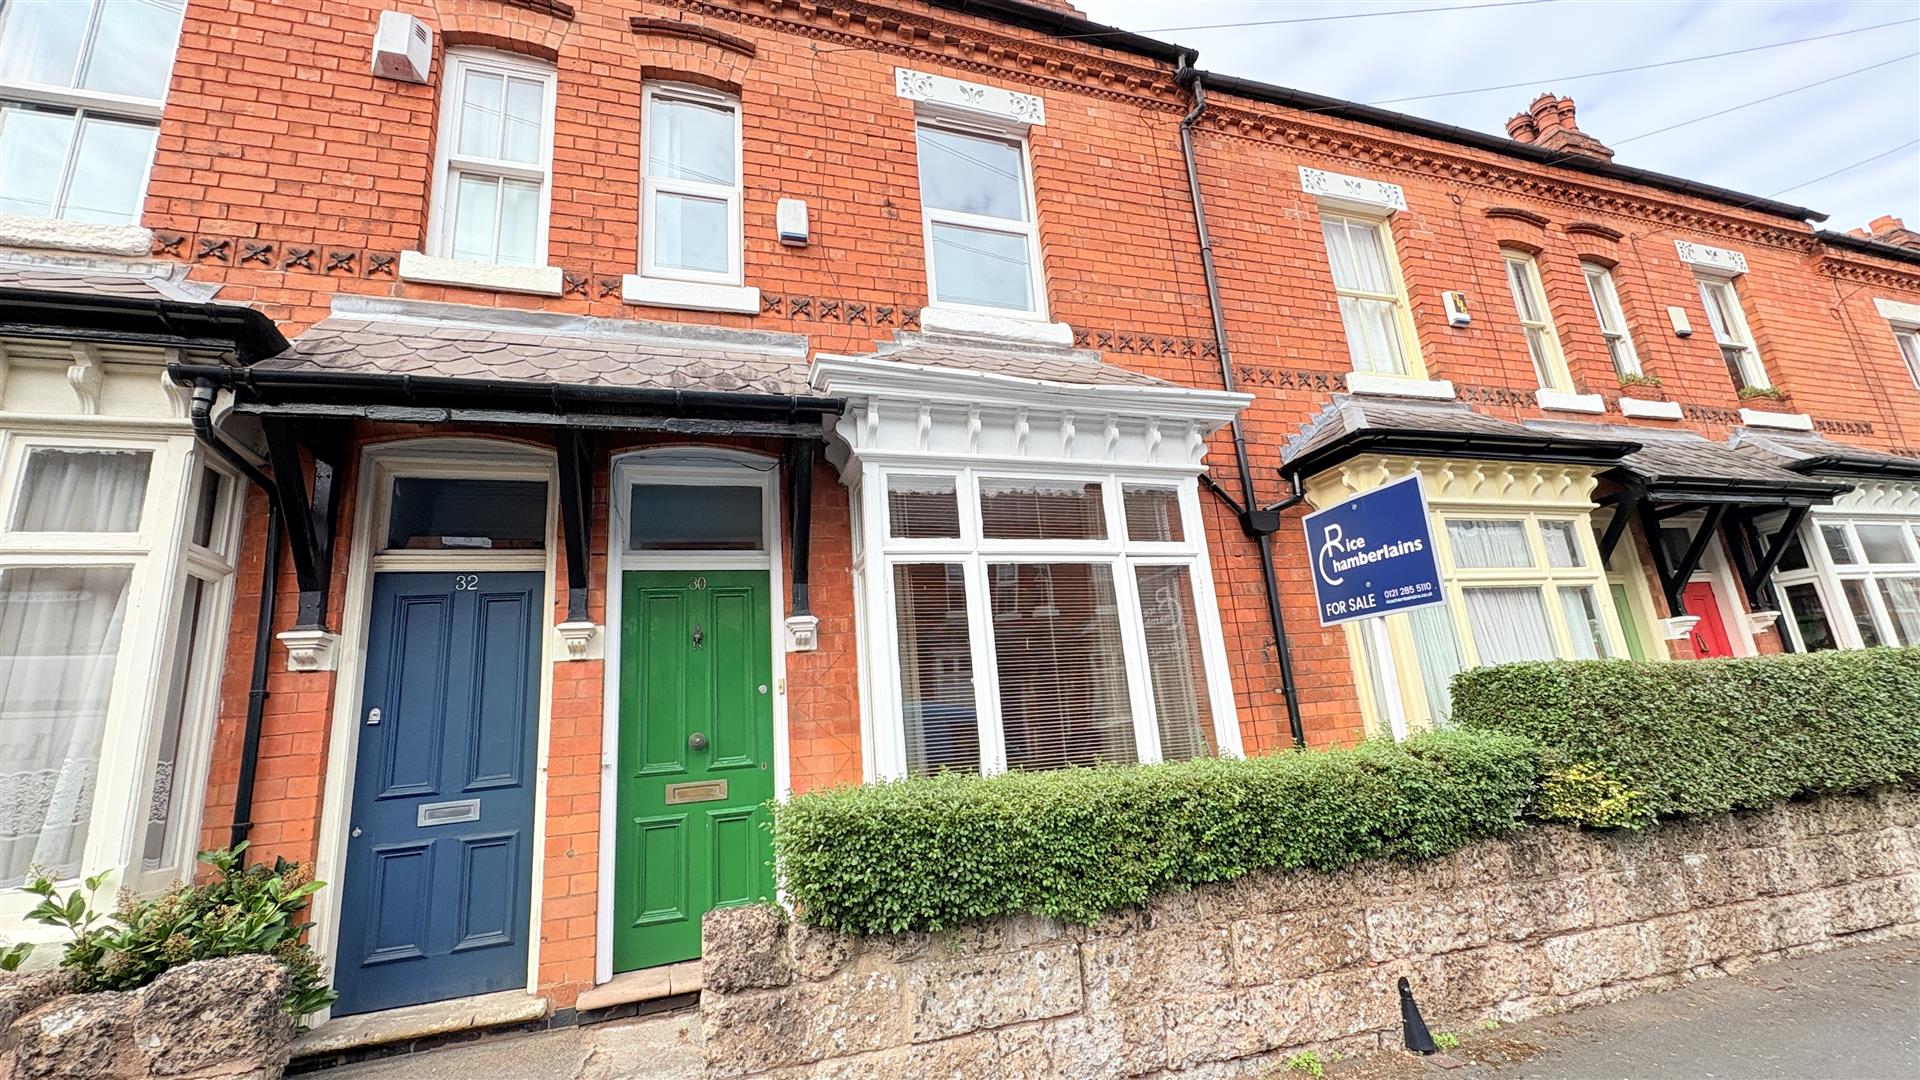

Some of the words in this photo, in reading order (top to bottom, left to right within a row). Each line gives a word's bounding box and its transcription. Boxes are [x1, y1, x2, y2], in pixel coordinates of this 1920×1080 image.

[1324, 523, 1366, 557] Rice
[1319, 538, 1423, 586] Chamberlains
[455, 575, 479, 591] 32
[688, 576, 707, 591] 30
[1384, 588, 1399, 599] 0121
[1399, 585, 1415, 596] 285
[1415, 582, 1432, 592] 5110
[1326, 601, 1347, 616] FOR
[1348, 593, 1377, 612] SALE
